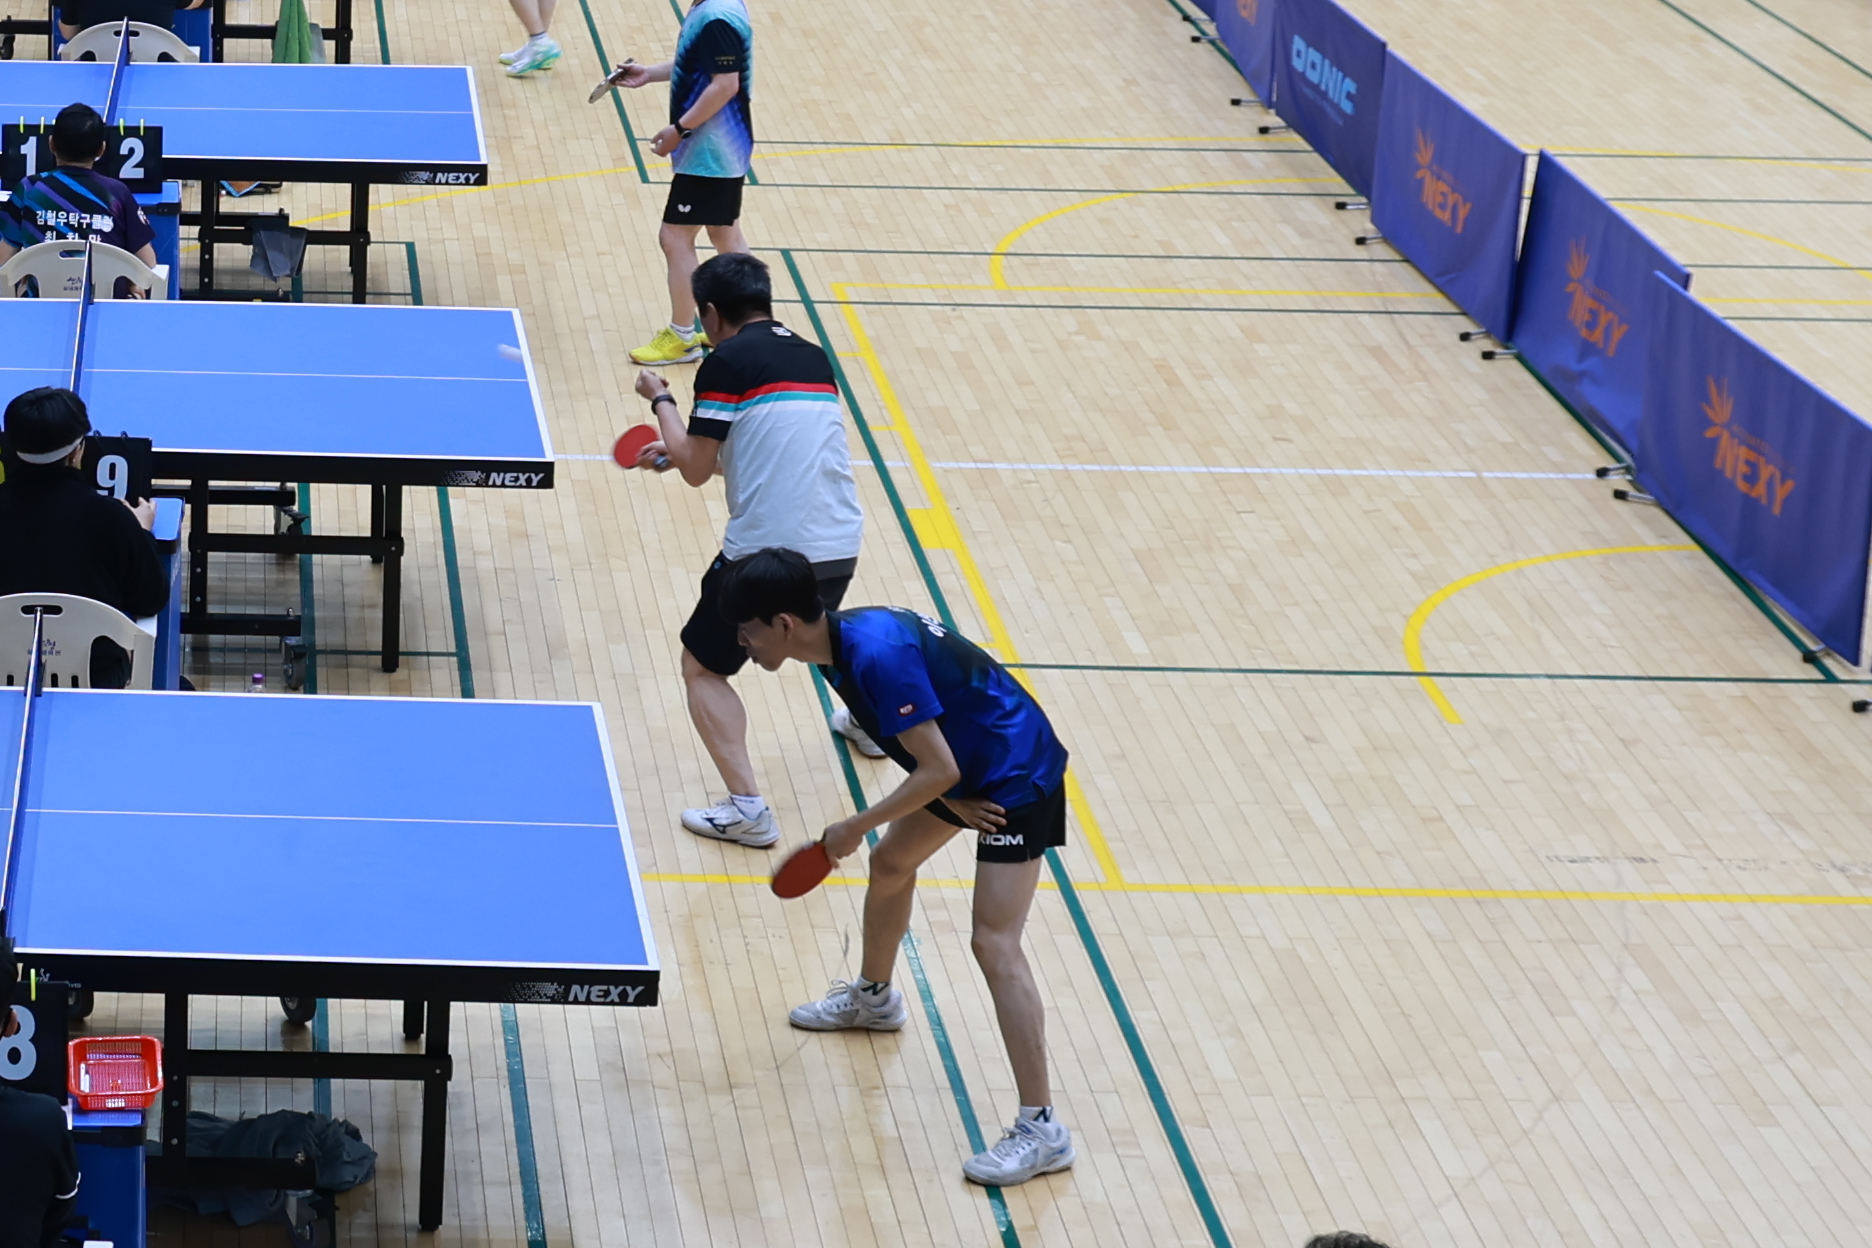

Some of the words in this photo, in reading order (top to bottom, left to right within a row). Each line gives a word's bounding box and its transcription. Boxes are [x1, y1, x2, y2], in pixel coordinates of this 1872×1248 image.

[1290, 33, 1358, 116] DONIC
[20, 137, 37, 177] 1
[118, 137, 145, 179] 2
[434, 171, 481, 185] NEXY
[1419, 170, 1473, 234] NEXY
[1566, 282, 1630, 358] NEXY
[96, 454, 129, 500] 9
[487, 471, 547, 488] NEXY
[1713, 429, 1797, 517] NEXY
[566, 983, 646, 1004] NEXY
